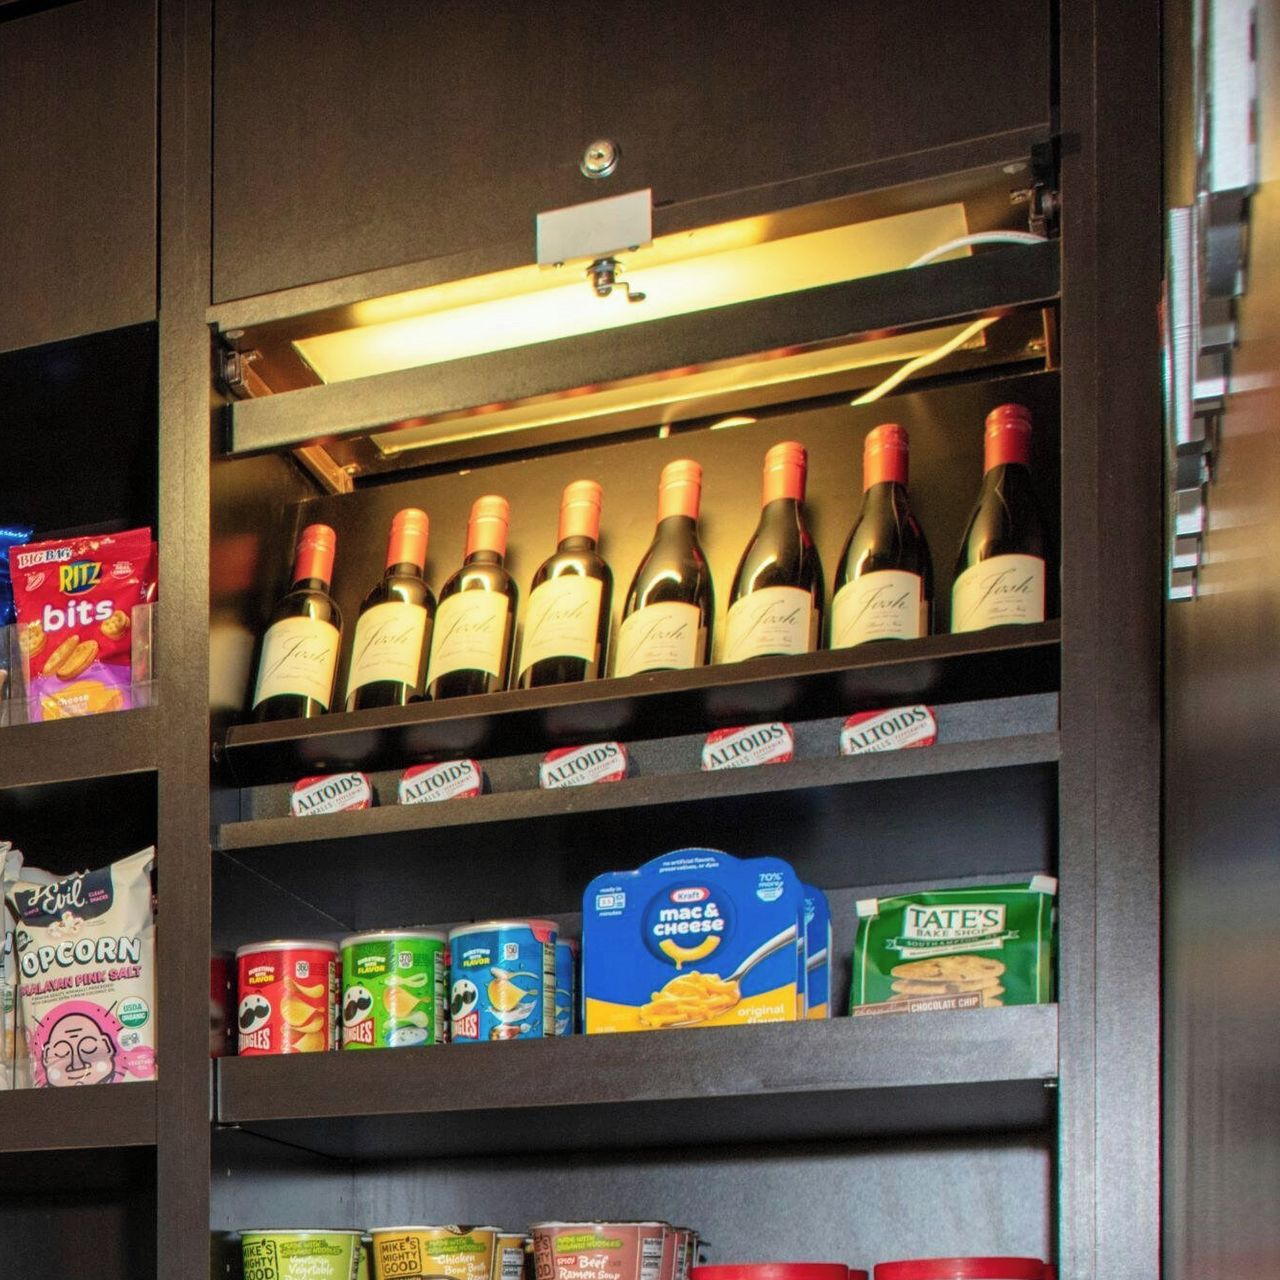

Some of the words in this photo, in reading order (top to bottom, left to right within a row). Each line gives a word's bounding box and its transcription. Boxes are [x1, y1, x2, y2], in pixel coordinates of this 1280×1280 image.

[17, 550, 42, 568] BIG
[45, 547, 72, 561] BAG
[59, 562, 102, 592] RITZ
[43, 599, 113, 631] bits
[847, 706, 927, 753] ALTOIDS
[706, 723, 784, 769] ALTOIDS
[546, 744, 618, 786] ALTOIDS
[403, 761, 471, 801] ALTOIDS
[297, 773, 363, 813] ALTOIDS
[759, 872, 782, 882] 70%
[42, 879, 85, 914] Evil
[677, 891, 700, 900] Kraft
[659, 905, 702, 921] mac
[704, 903, 720, 918] &
[909, 908, 1000, 929] TATE'S
[954, 928, 989, 936] SHOP
[20, 936, 141, 978] OPCORN
[463, 957, 490, 967] FLAVOR
[358, 965, 385, 974] FLAVOR
[20, 975, 72, 997] MALAYAN
[75, 971, 106, 987] PINK
[109, 965, 142, 982] SALT
[248, 975, 275, 984] FLAVOR
[123, 1003, 143, 1012] USDA
[737, 1005, 785, 1018] original
[911, 1000, 956, 1013] CHOCOLATE
[958, 997, 979, 1008] CHIP
[382, 1240, 417, 1252] MIKE'S
[383, 1252, 417, 1262] MIGHTY
[437, 1254, 476, 1264] Chicken
[579, 1254, 609, 1268] Beef
[288, 1263, 334, 1276] Vegetable
[384, 1261, 418, 1273] GOOD
[559, 1267, 597, 1280] Ramen
[245, 1268, 275, 1280] GOOD
